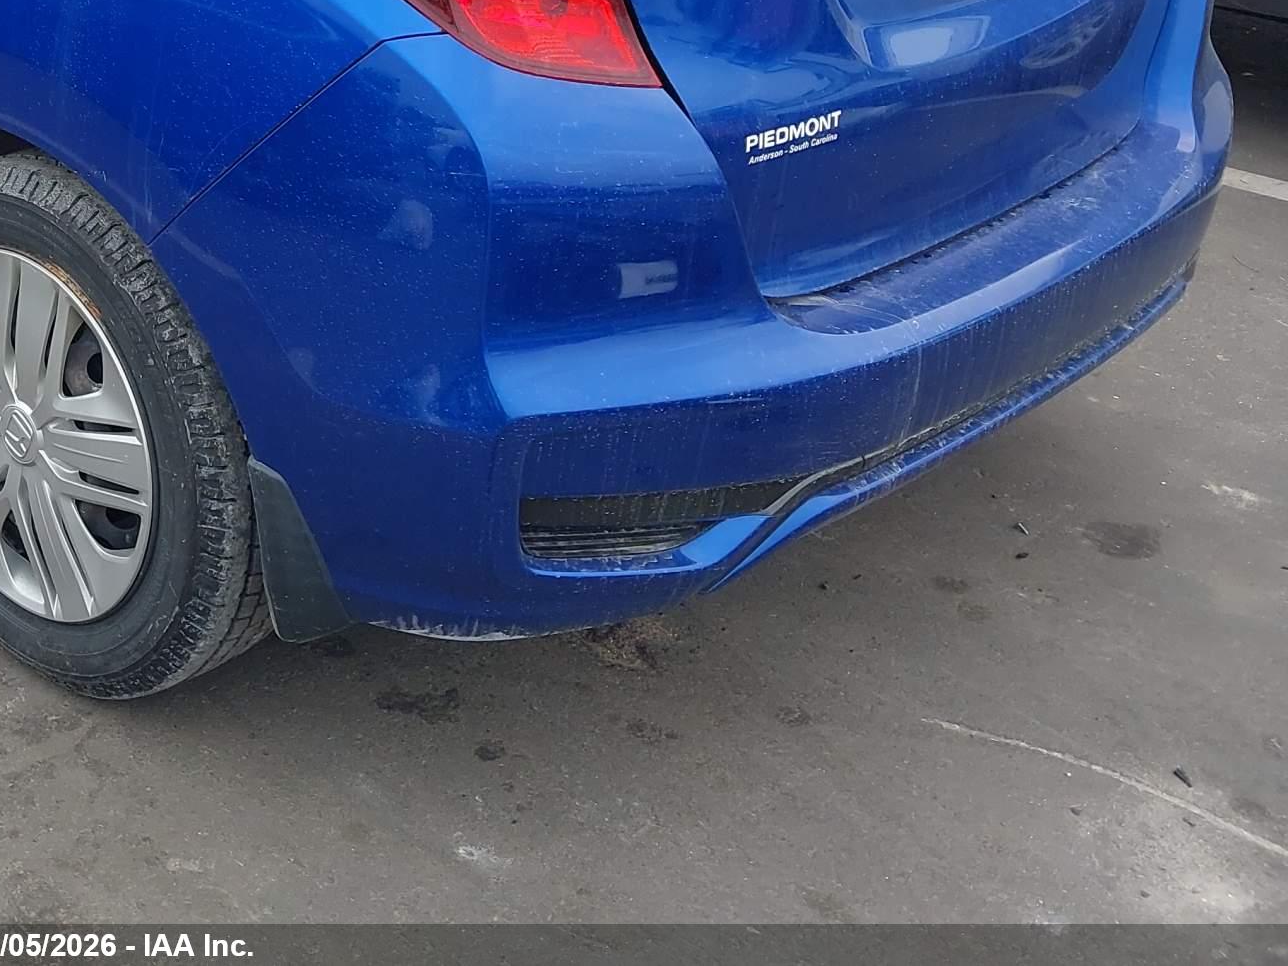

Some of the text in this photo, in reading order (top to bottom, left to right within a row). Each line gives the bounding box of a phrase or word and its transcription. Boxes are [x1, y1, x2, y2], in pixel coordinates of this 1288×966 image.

[745, 110, 842, 153] PIEDMONT
[748, 149, 784, 165] Anderson
[789, 141, 810, 155] South
[811, 133, 838, 147] Carolina
